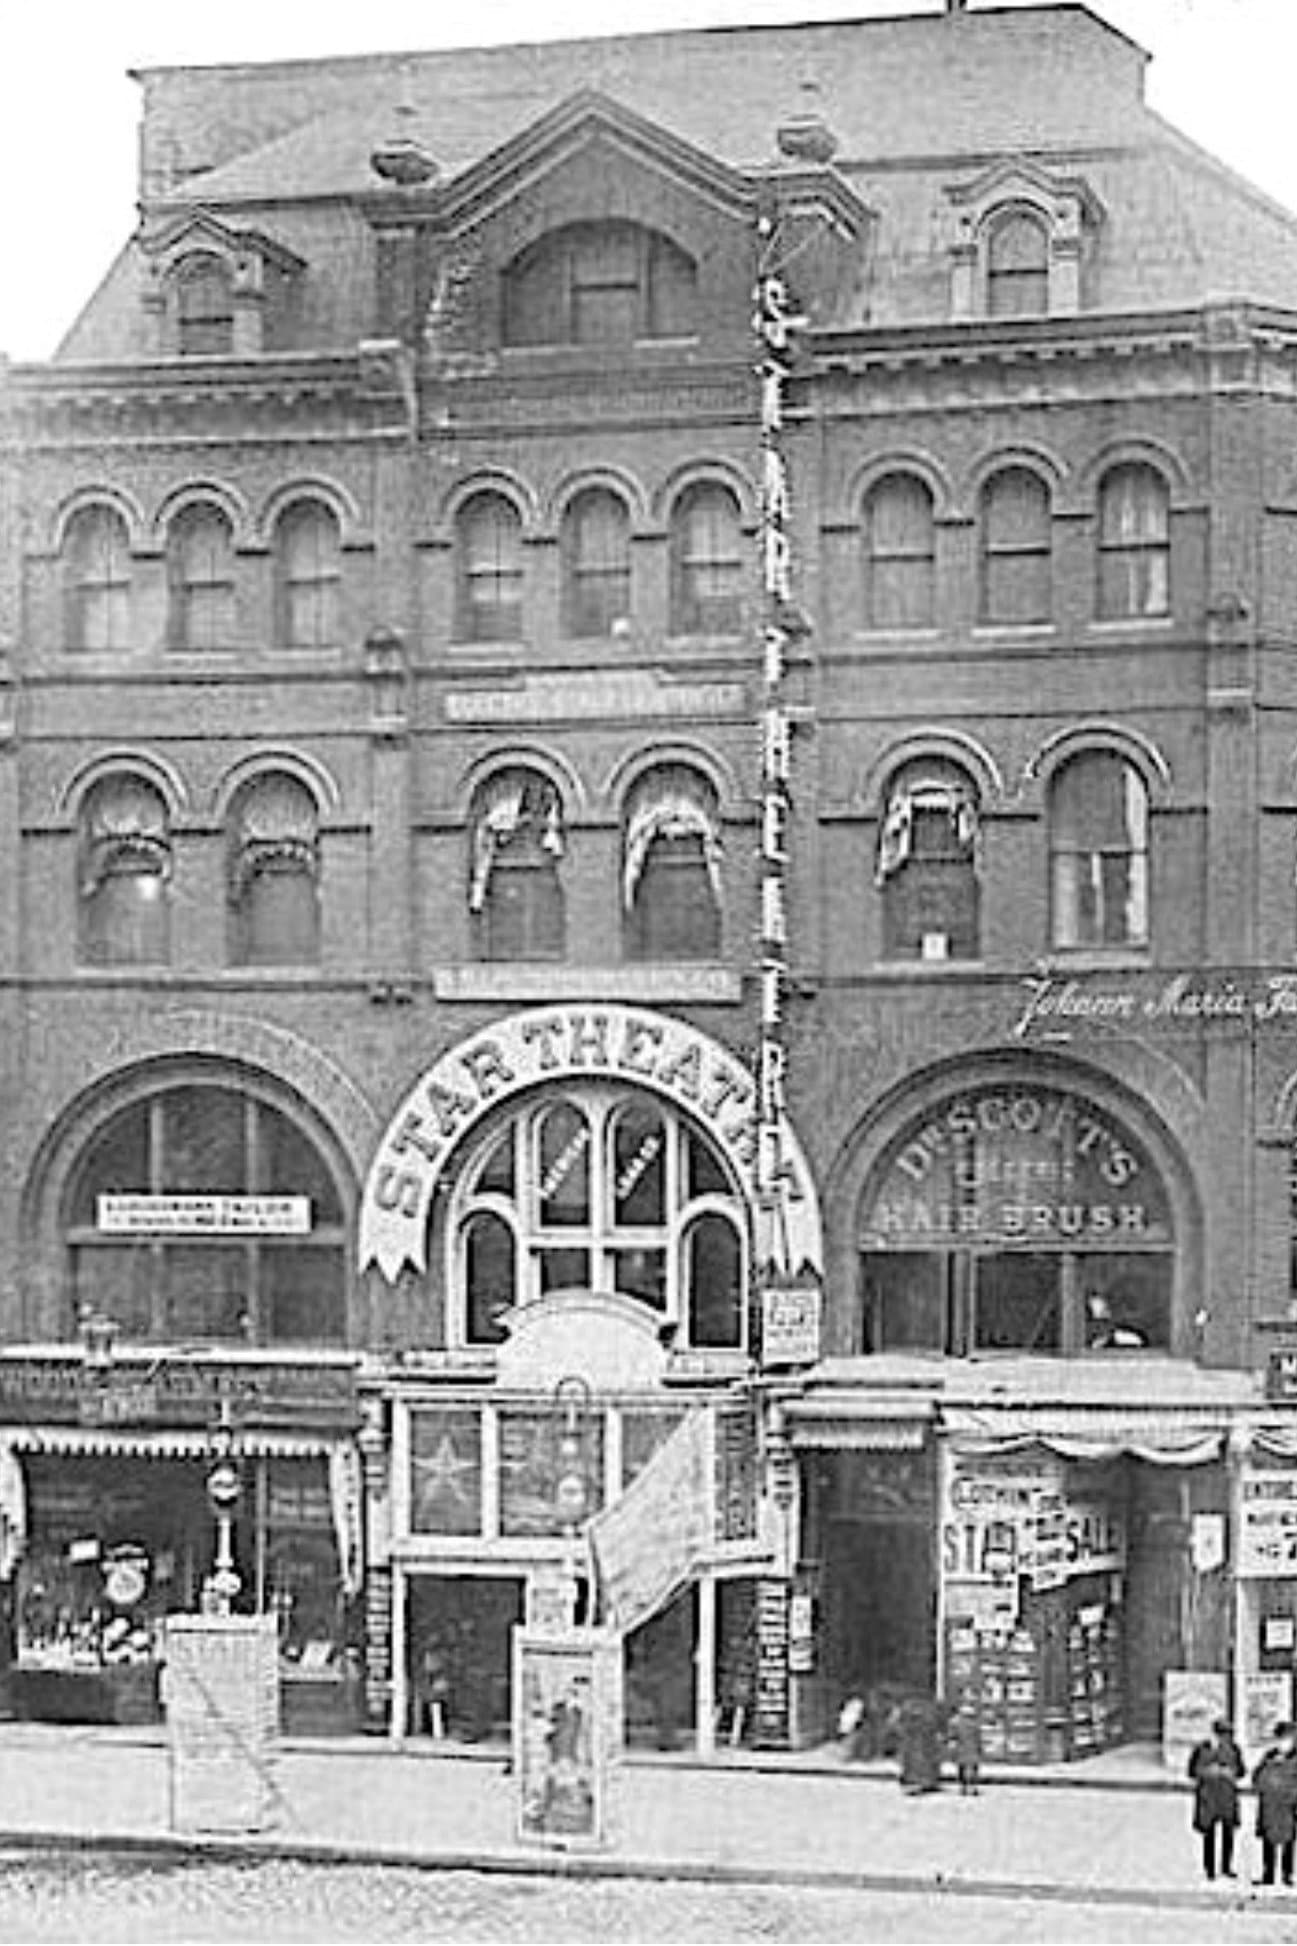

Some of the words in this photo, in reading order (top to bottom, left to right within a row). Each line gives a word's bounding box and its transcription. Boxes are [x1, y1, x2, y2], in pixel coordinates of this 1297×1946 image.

[1014, 976, 1134, 1036] Johann
[1142, 973, 1246, 1019] Maria
[373, 1039, 517, 1219] STAR
[877, 1203, 980, 1232] HAIR
[1000, 1204, 1146, 1235] BRUSH
